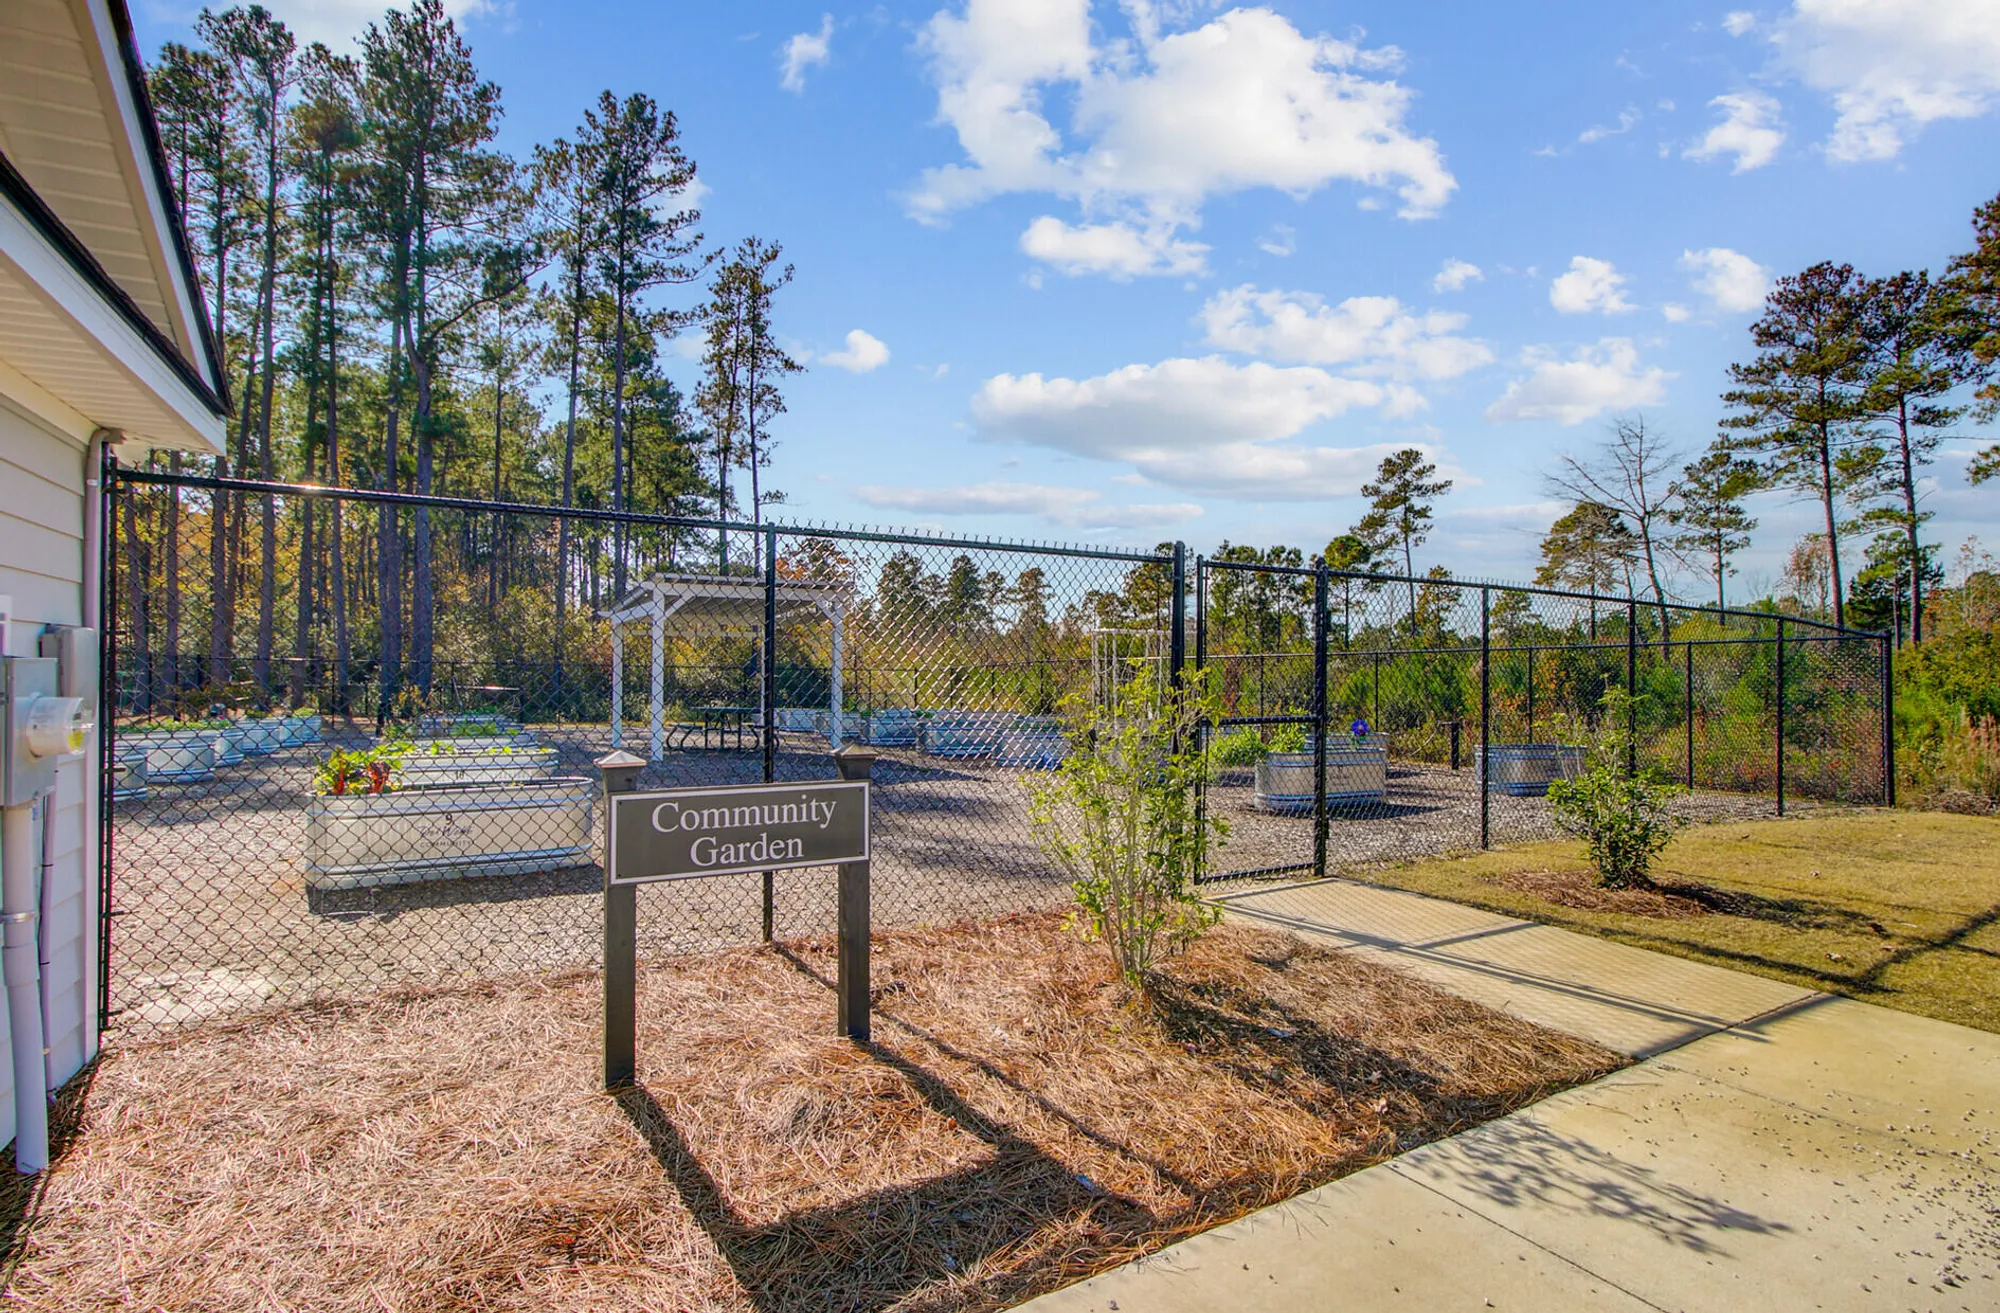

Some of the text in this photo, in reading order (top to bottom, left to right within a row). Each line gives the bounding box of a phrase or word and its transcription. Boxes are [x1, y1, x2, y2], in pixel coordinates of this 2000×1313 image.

[445, 813, 453, 826] 9
[652, 794, 837, 833] Community
[690, 832, 804, 867] Garden
